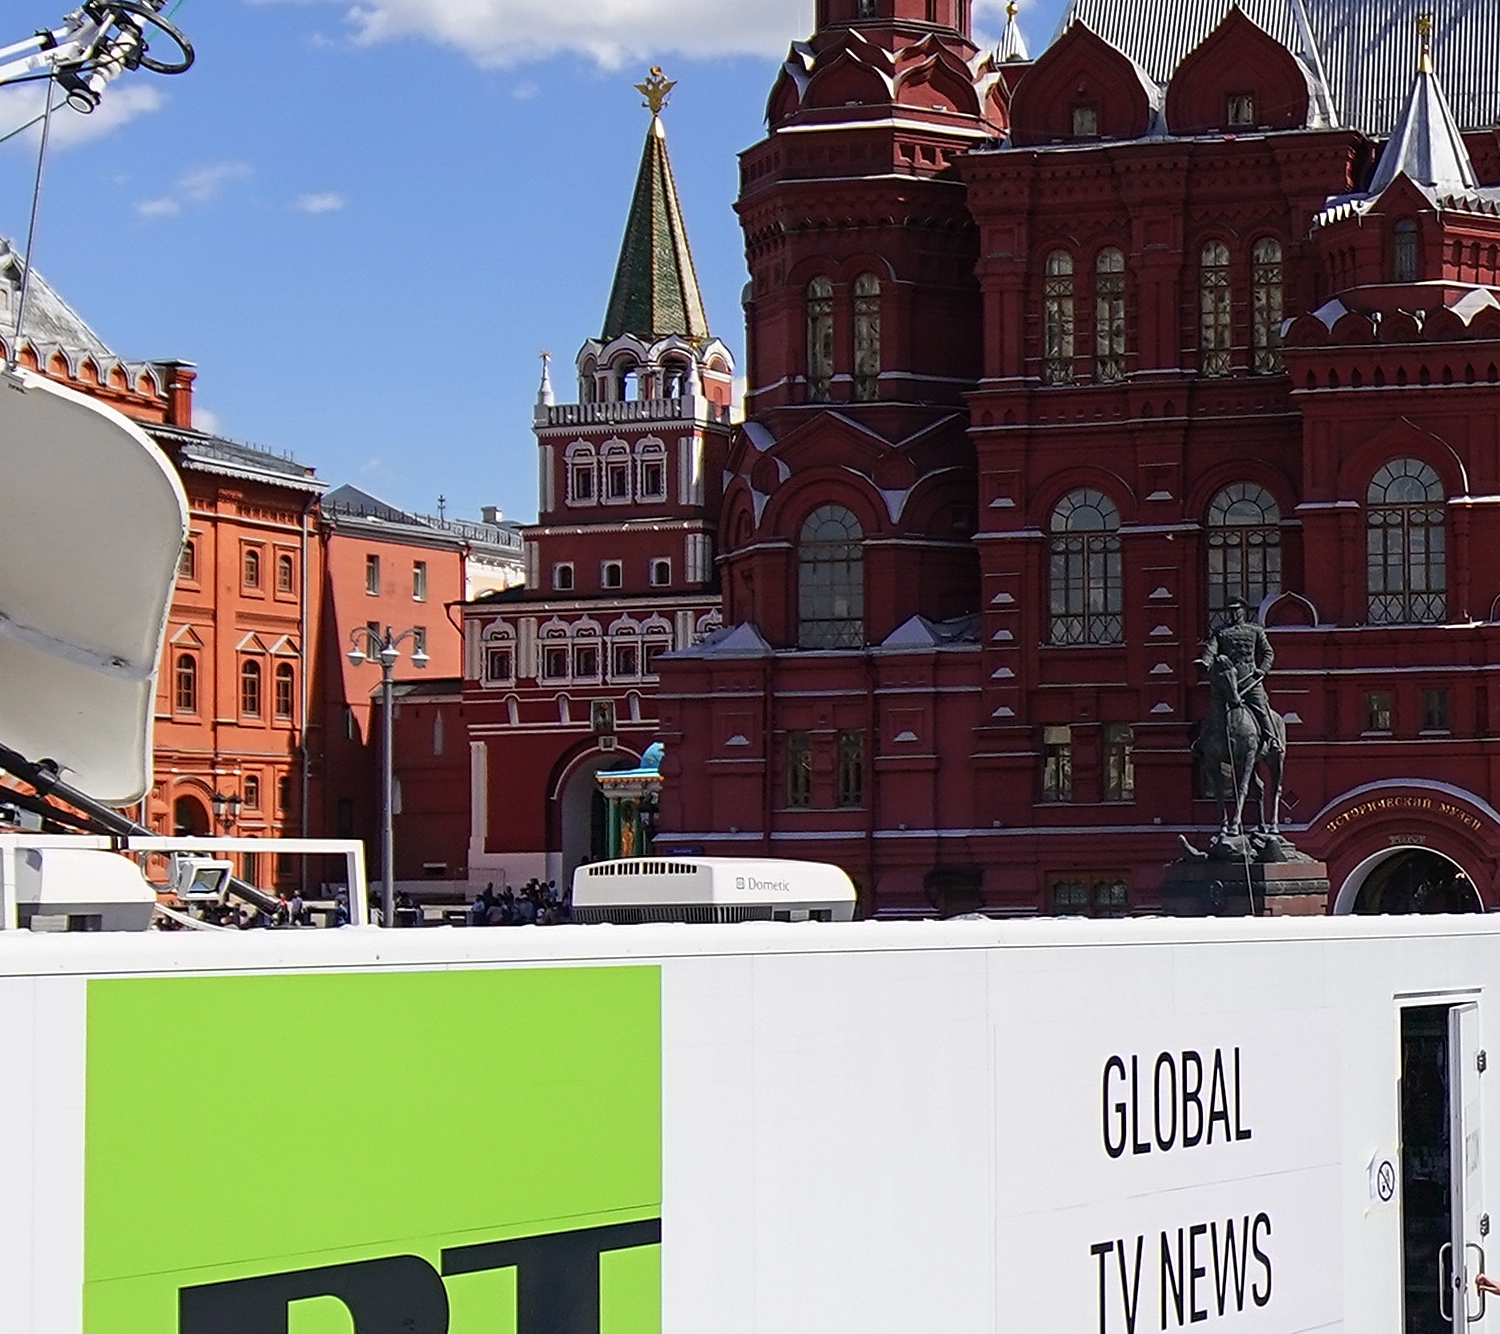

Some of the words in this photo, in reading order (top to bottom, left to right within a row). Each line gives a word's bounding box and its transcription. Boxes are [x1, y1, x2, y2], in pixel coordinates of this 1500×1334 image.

[1326, 798, 1432, 832] ИСТОРИЧЕСКИЙ
[1440, 803, 1483, 831] МУЗЕЙ
[747, 877, 790, 892] Dometic
[1102, 1046, 1252, 1159] GLOBAL
[1159, 1211, 1272, 1332] NEWS
